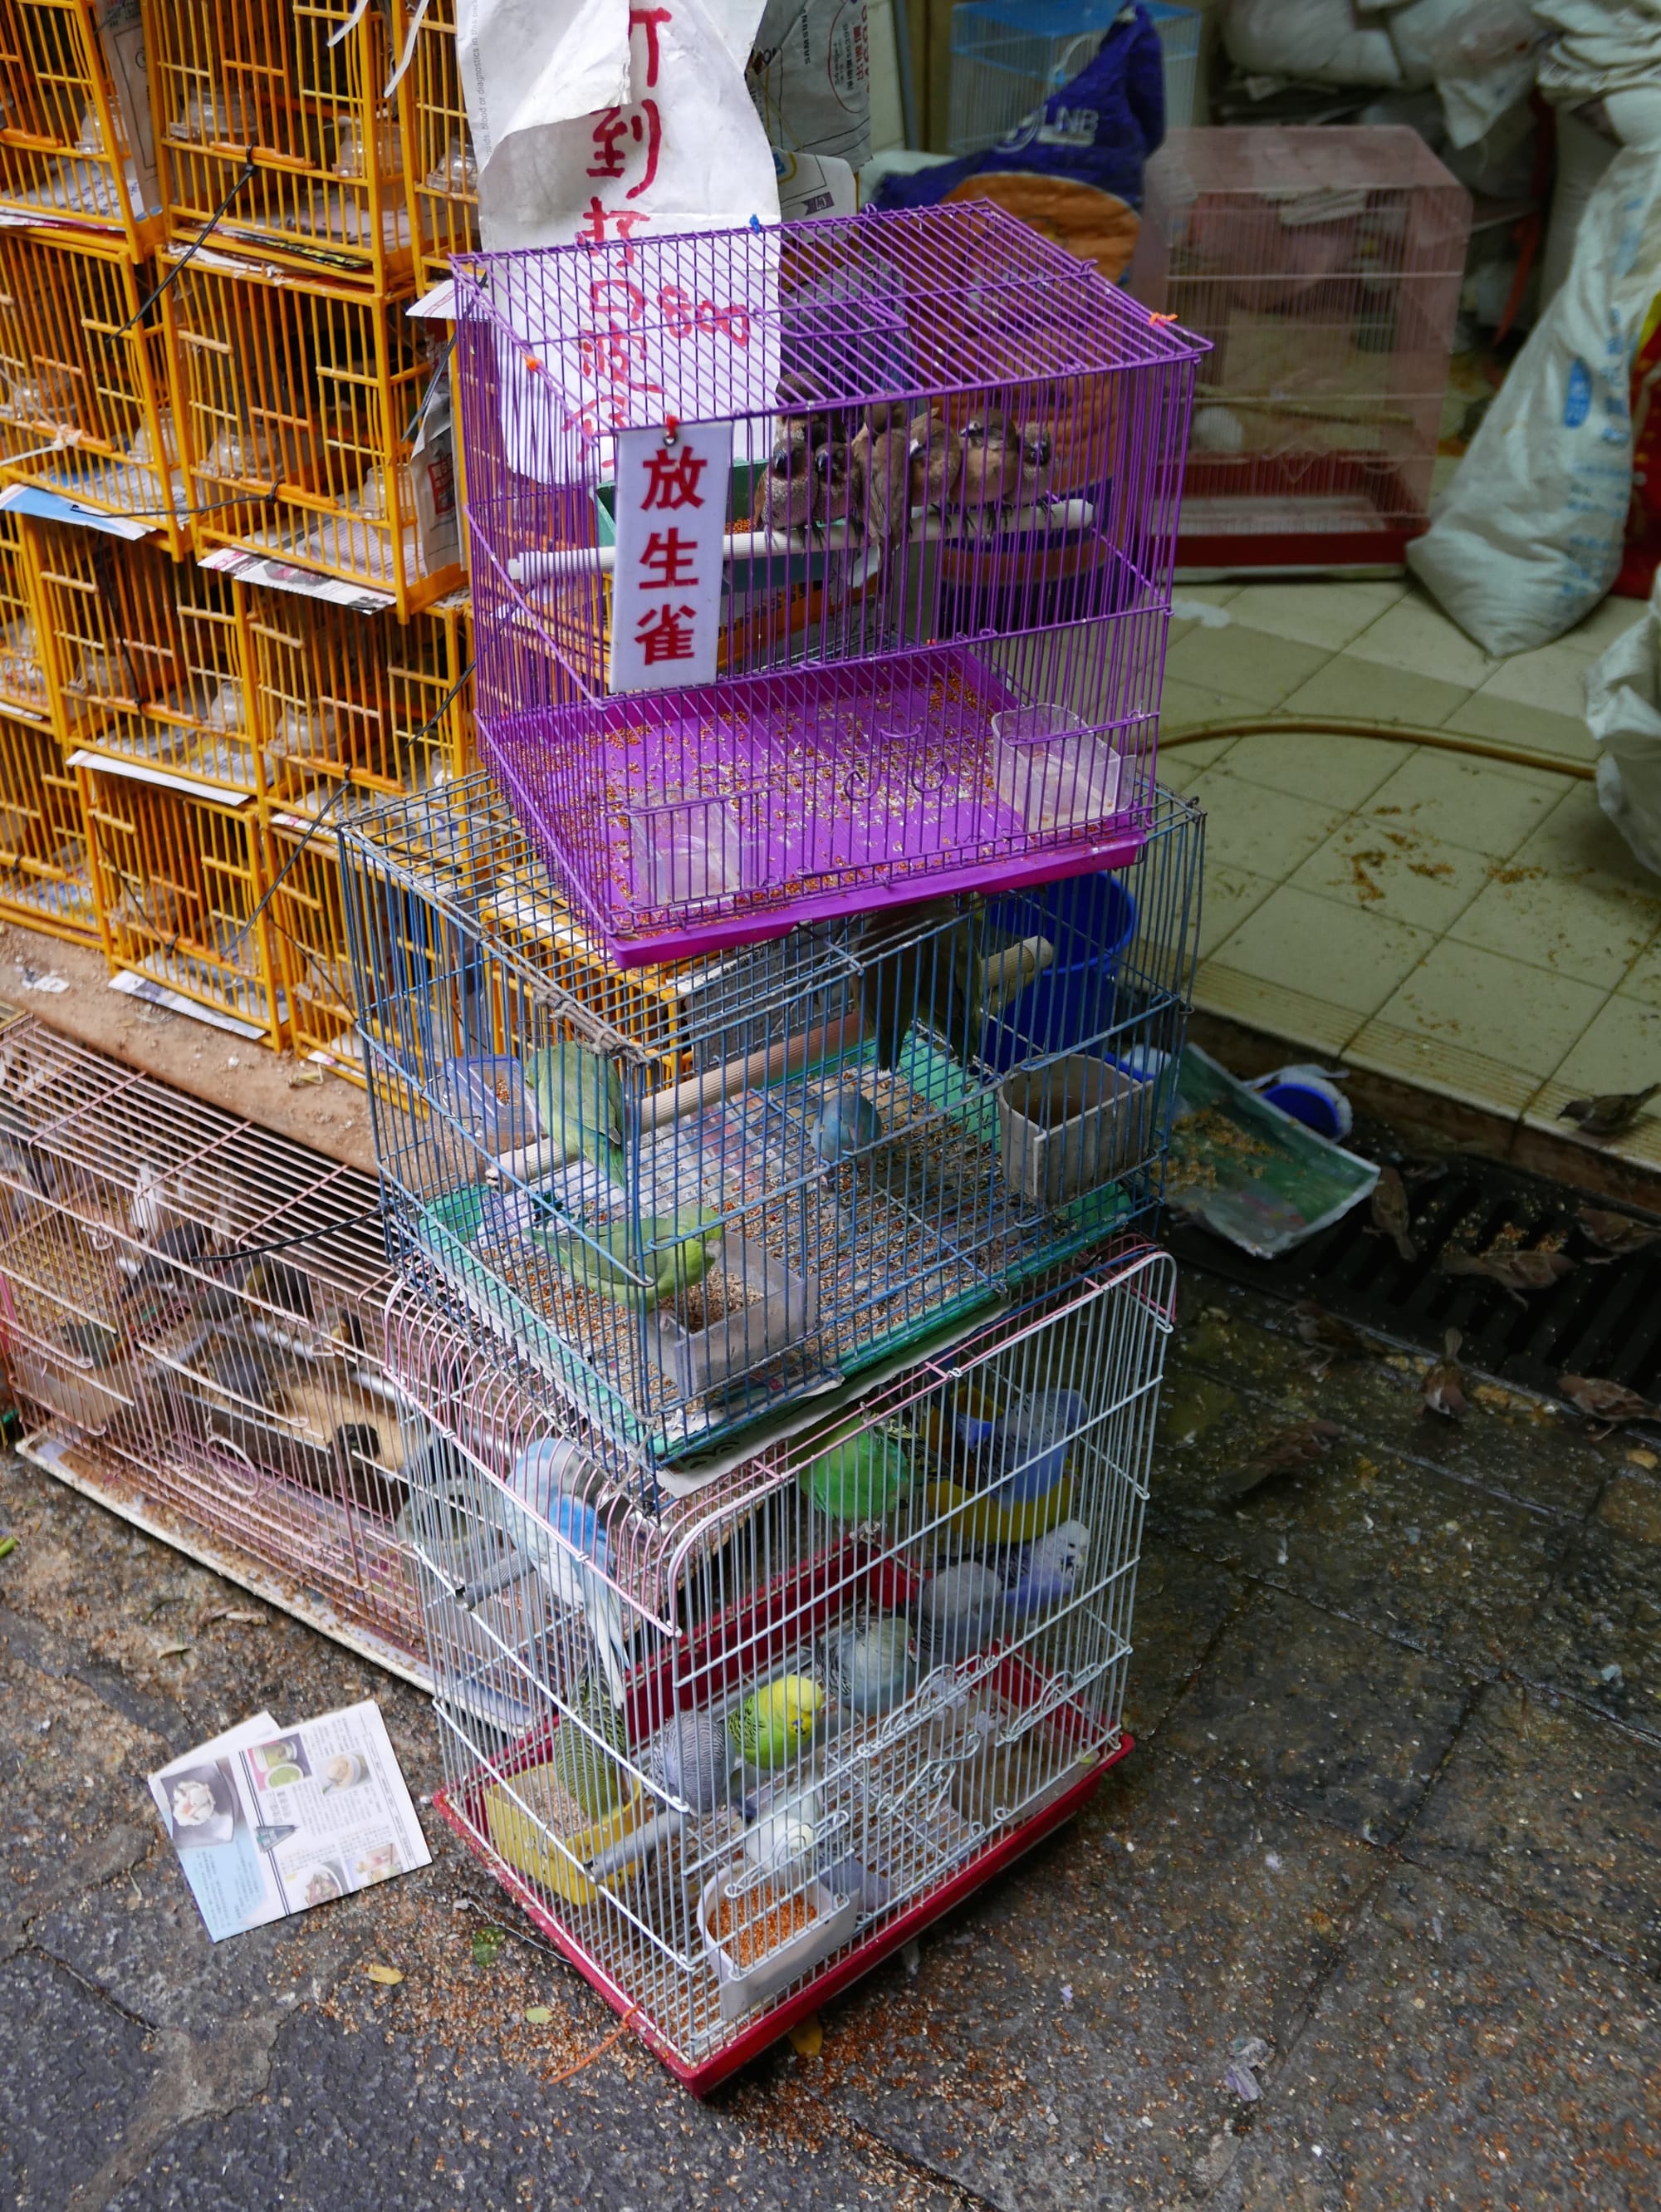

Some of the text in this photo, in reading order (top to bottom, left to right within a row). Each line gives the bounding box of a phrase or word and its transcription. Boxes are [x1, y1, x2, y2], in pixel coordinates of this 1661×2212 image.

[472, 37, 479, 46] in
[473, 48, 486, 95] diagnostics
[479, 97, 486, 105] or
[479, 108, 489, 130] blood
[635, 445, 708, 666] 放生雀
